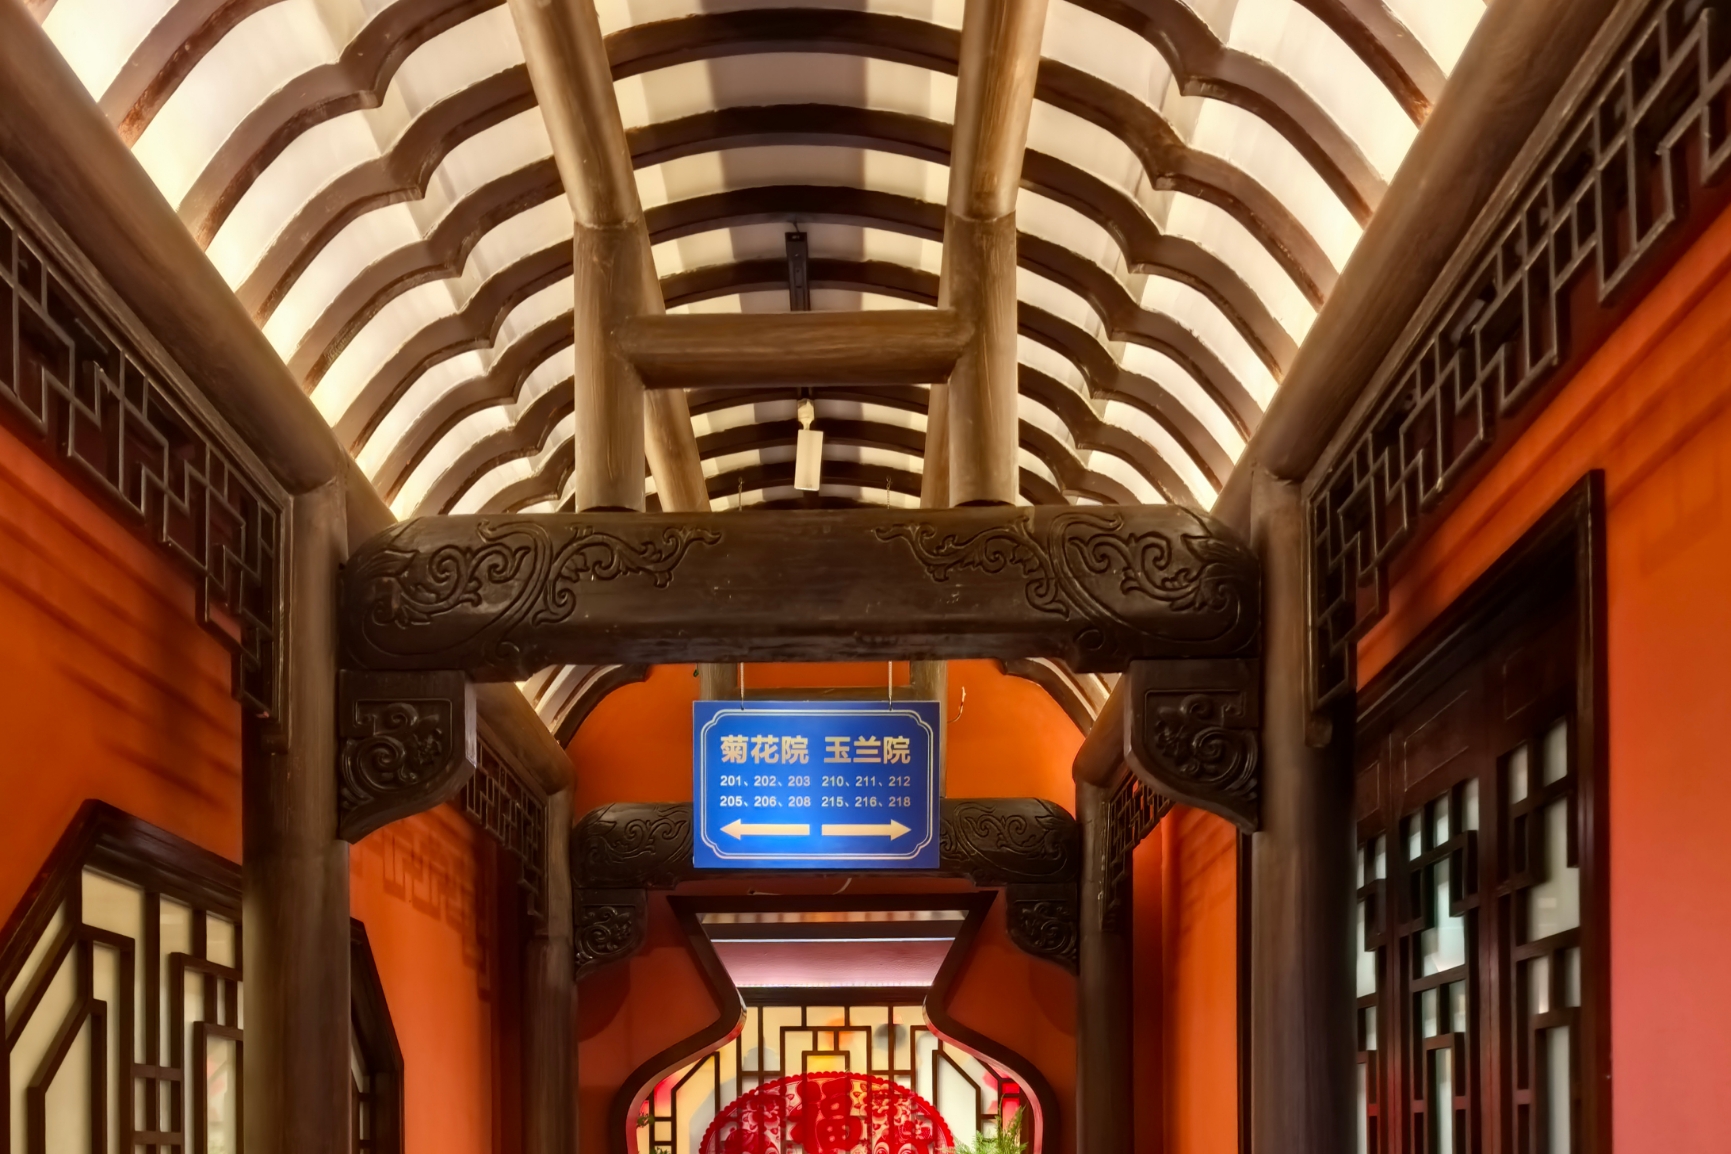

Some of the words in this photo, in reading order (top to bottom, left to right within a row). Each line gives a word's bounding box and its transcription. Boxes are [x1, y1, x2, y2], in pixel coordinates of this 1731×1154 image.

[720, 734, 809, 764] 菊花院
[823, 735, 911, 764] 玉兰院
[720, 775, 811, 787] 201、202、203
[821, 775, 911, 787] 210、211、212
[719, 795, 811, 808] 205、206、208
[821, 795, 911, 808] 215、216、218
[788, 1077, 862, 1153] 福
